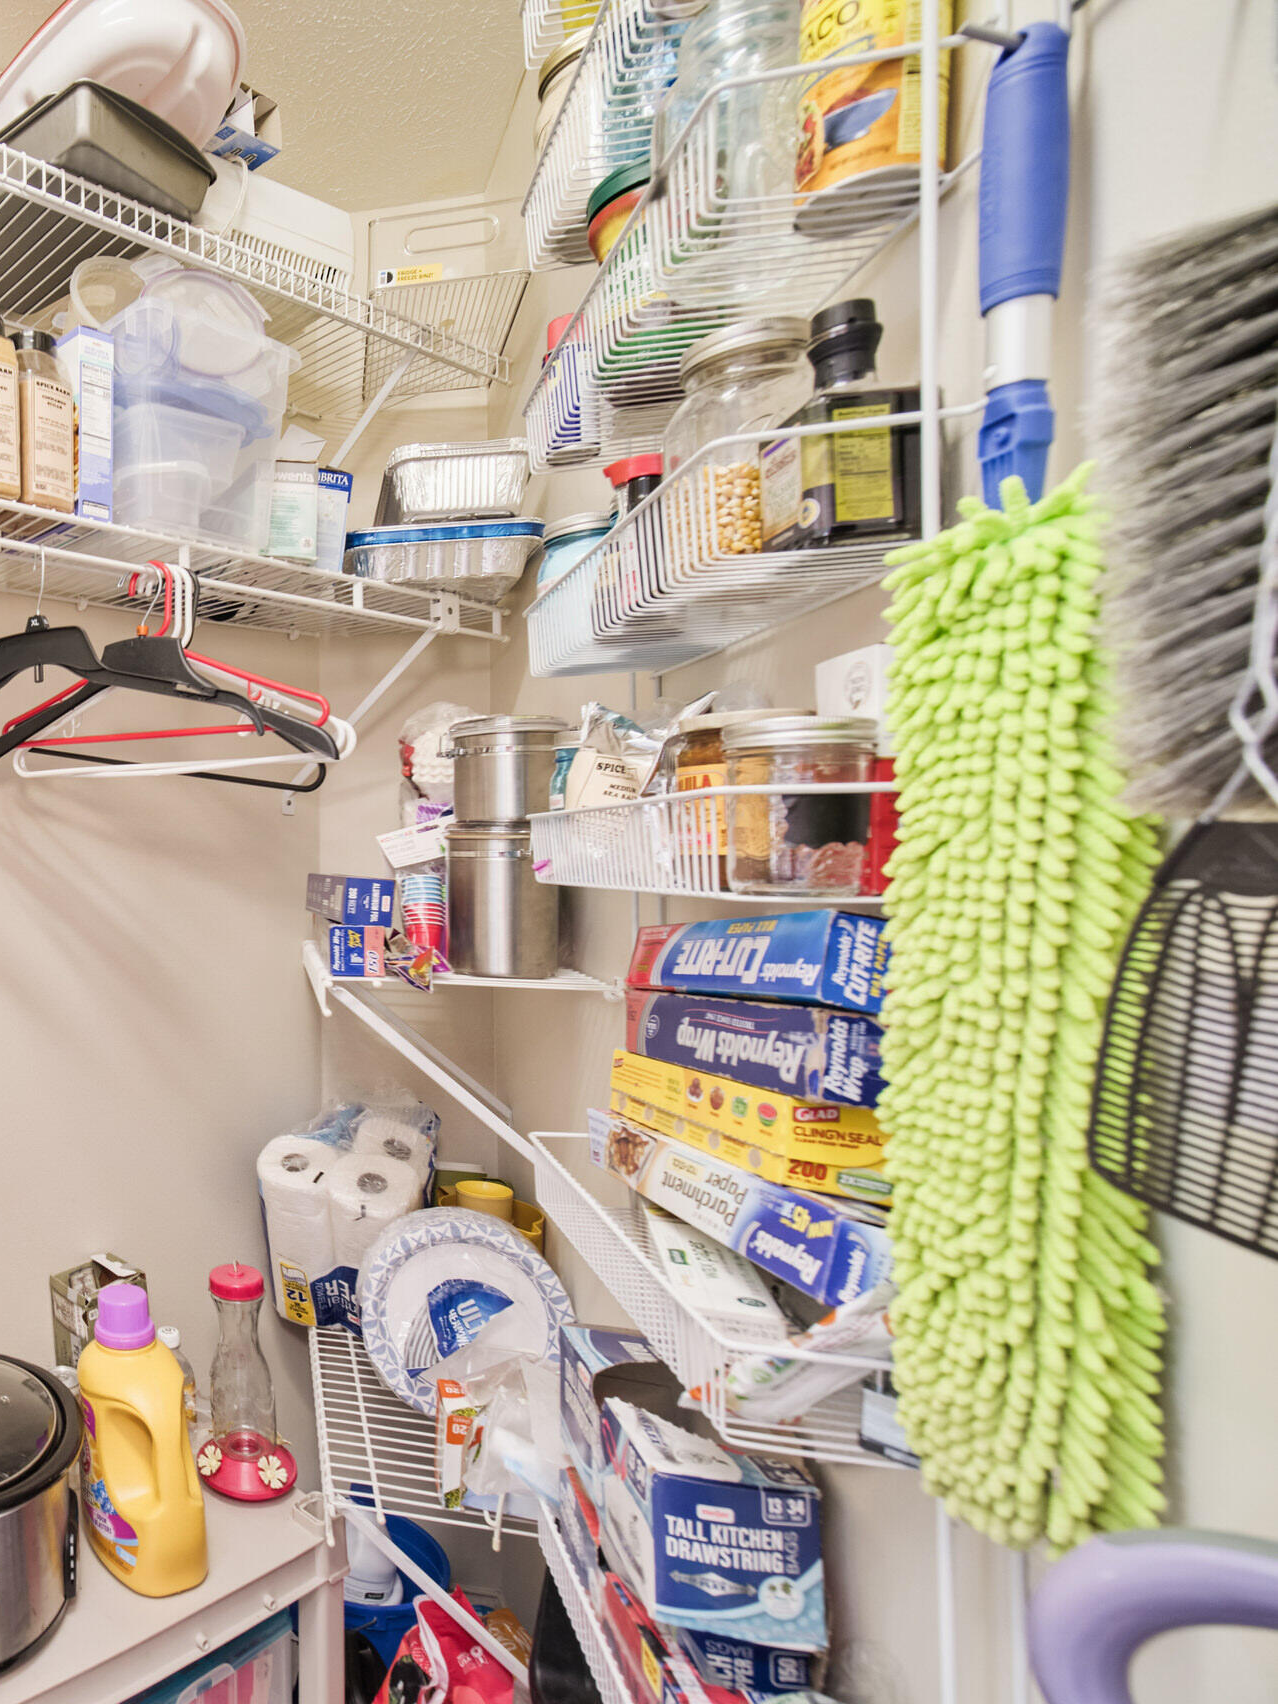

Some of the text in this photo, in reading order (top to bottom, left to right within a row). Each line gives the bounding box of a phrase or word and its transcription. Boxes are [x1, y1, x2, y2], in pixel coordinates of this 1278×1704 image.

[808, 0, 859, 46] ACO
[36, 381, 71, 397] SPICE BARN
[321, 472, 349, 486] BRITA
[596, 762, 626, 774] SPICE
[370, 882, 381, 923] ALUMINUM FOIL
[727, 919, 778, 935] WAX PAPER
[332, 945, 341, 971] Reynolds
[367, 950, 380, 974] 150
[672, 936, 771, 985] CUT-RITE
[759, 958, 821, 986] Reynolds
[830, 929, 853, 987] Reynolds
[675, 1016, 717, 1064] Wrap
[715, 1030, 805, 1084] Reynolds
[822, 1018, 849, 1094] Reynolds
[843, 1055, 869, 1102] Wrap
[795, 1107, 839, 1122] GLAD
[848, 1132, 883, 1146] SEAL
[788, 1158, 828, 1180] 200
[660, 1170, 739, 1228] Parchment
[705, 1170, 749, 1205] Paper
[748, 1229, 824, 1286] Reynolds
[286, 1287, 308, 1302] 12
[456, 1298, 486, 1335] ULT
[767, 1497, 784, 1515] 13
[664, 1513, 784, 1551] TALL KITCHEN
[665, 1535, 785, 1574] DRAWSTRING
[784, 1530, 801, 1575] BAGS
[778, 1657, 799, 1683] 150
